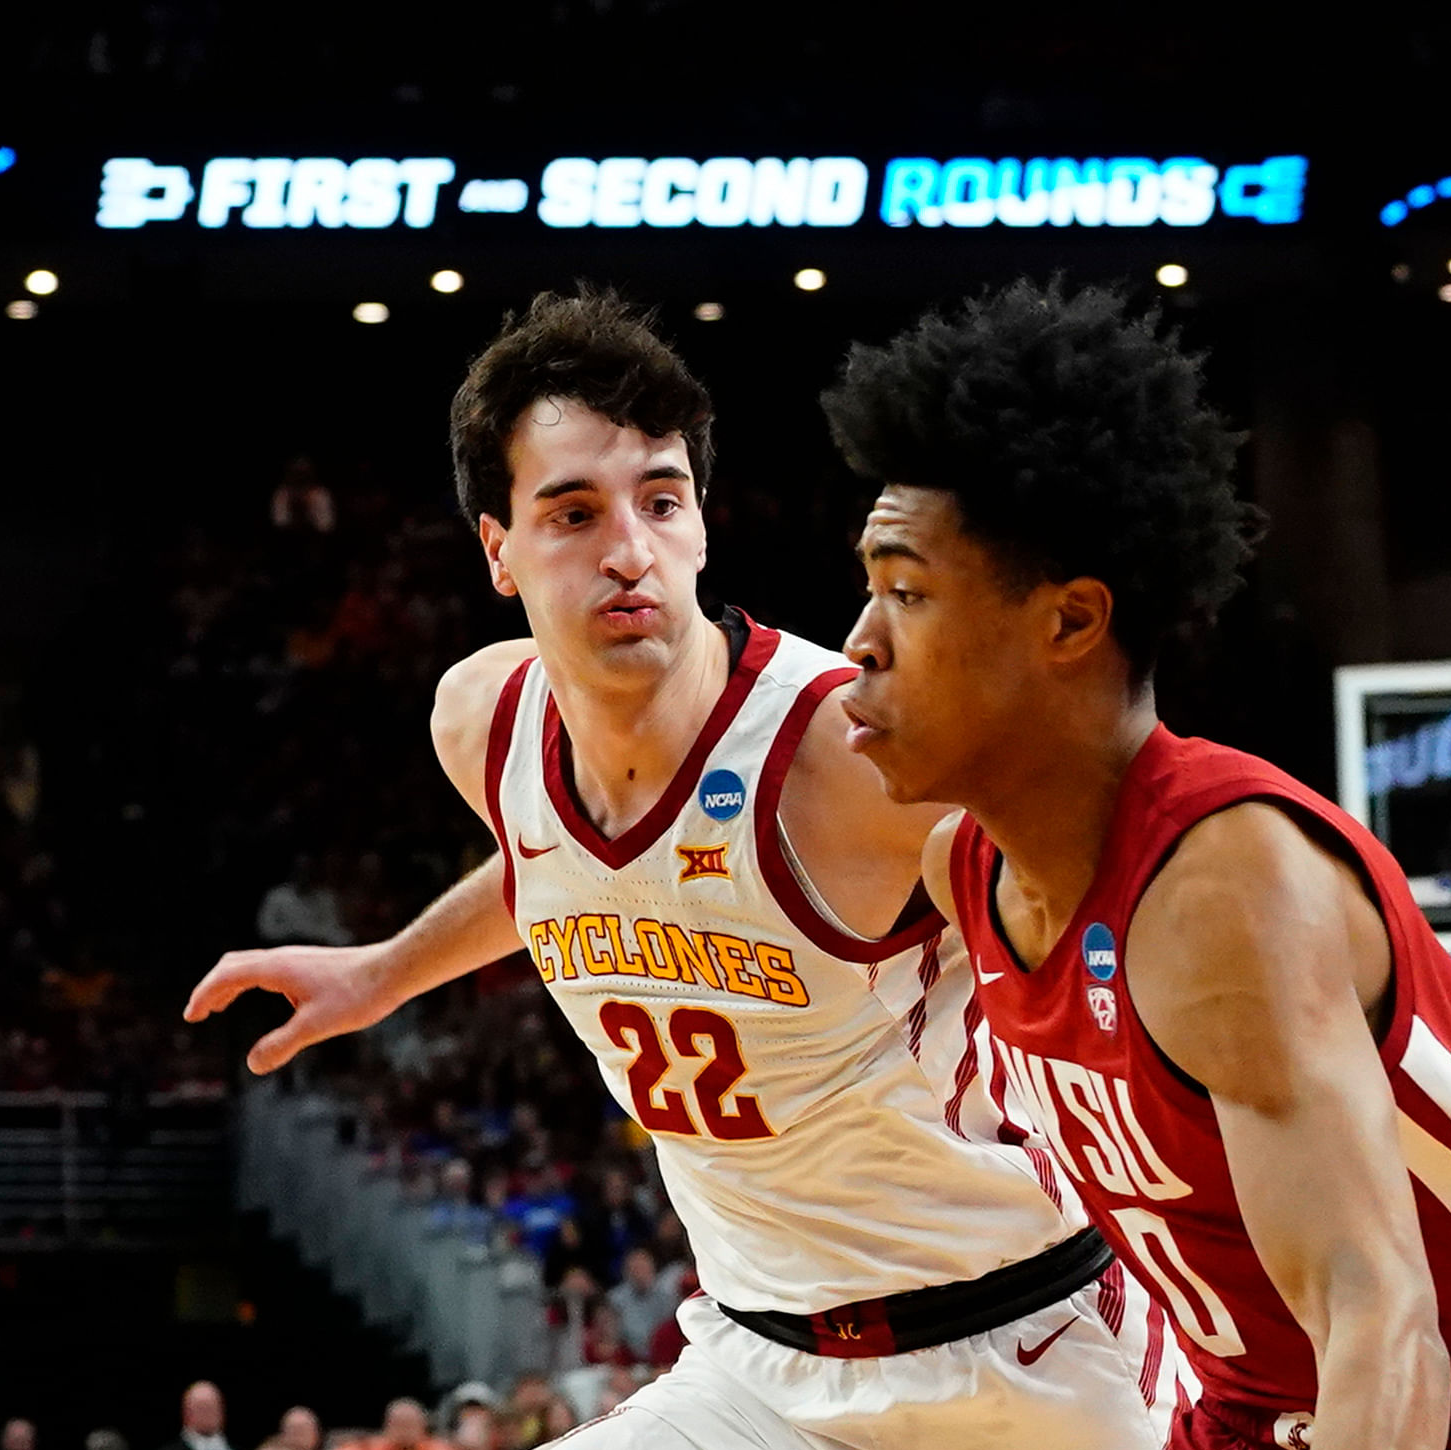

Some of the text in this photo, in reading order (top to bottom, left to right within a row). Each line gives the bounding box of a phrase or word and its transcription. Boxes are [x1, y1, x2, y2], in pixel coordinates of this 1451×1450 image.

[197, 157, 456, 228] FIRST
[537, 156, 869, 228] SECOND
[879, 156, 1221, 228] ROUNDS
[704, 792, 743, 809] NCAA
[529, 913, 810, 1008] CYCLONES
[599, 998, 778, 1140] 22
[992, 1035, 1195, 1202] WSU
[1108, 1206, 1248, 1359] 0
